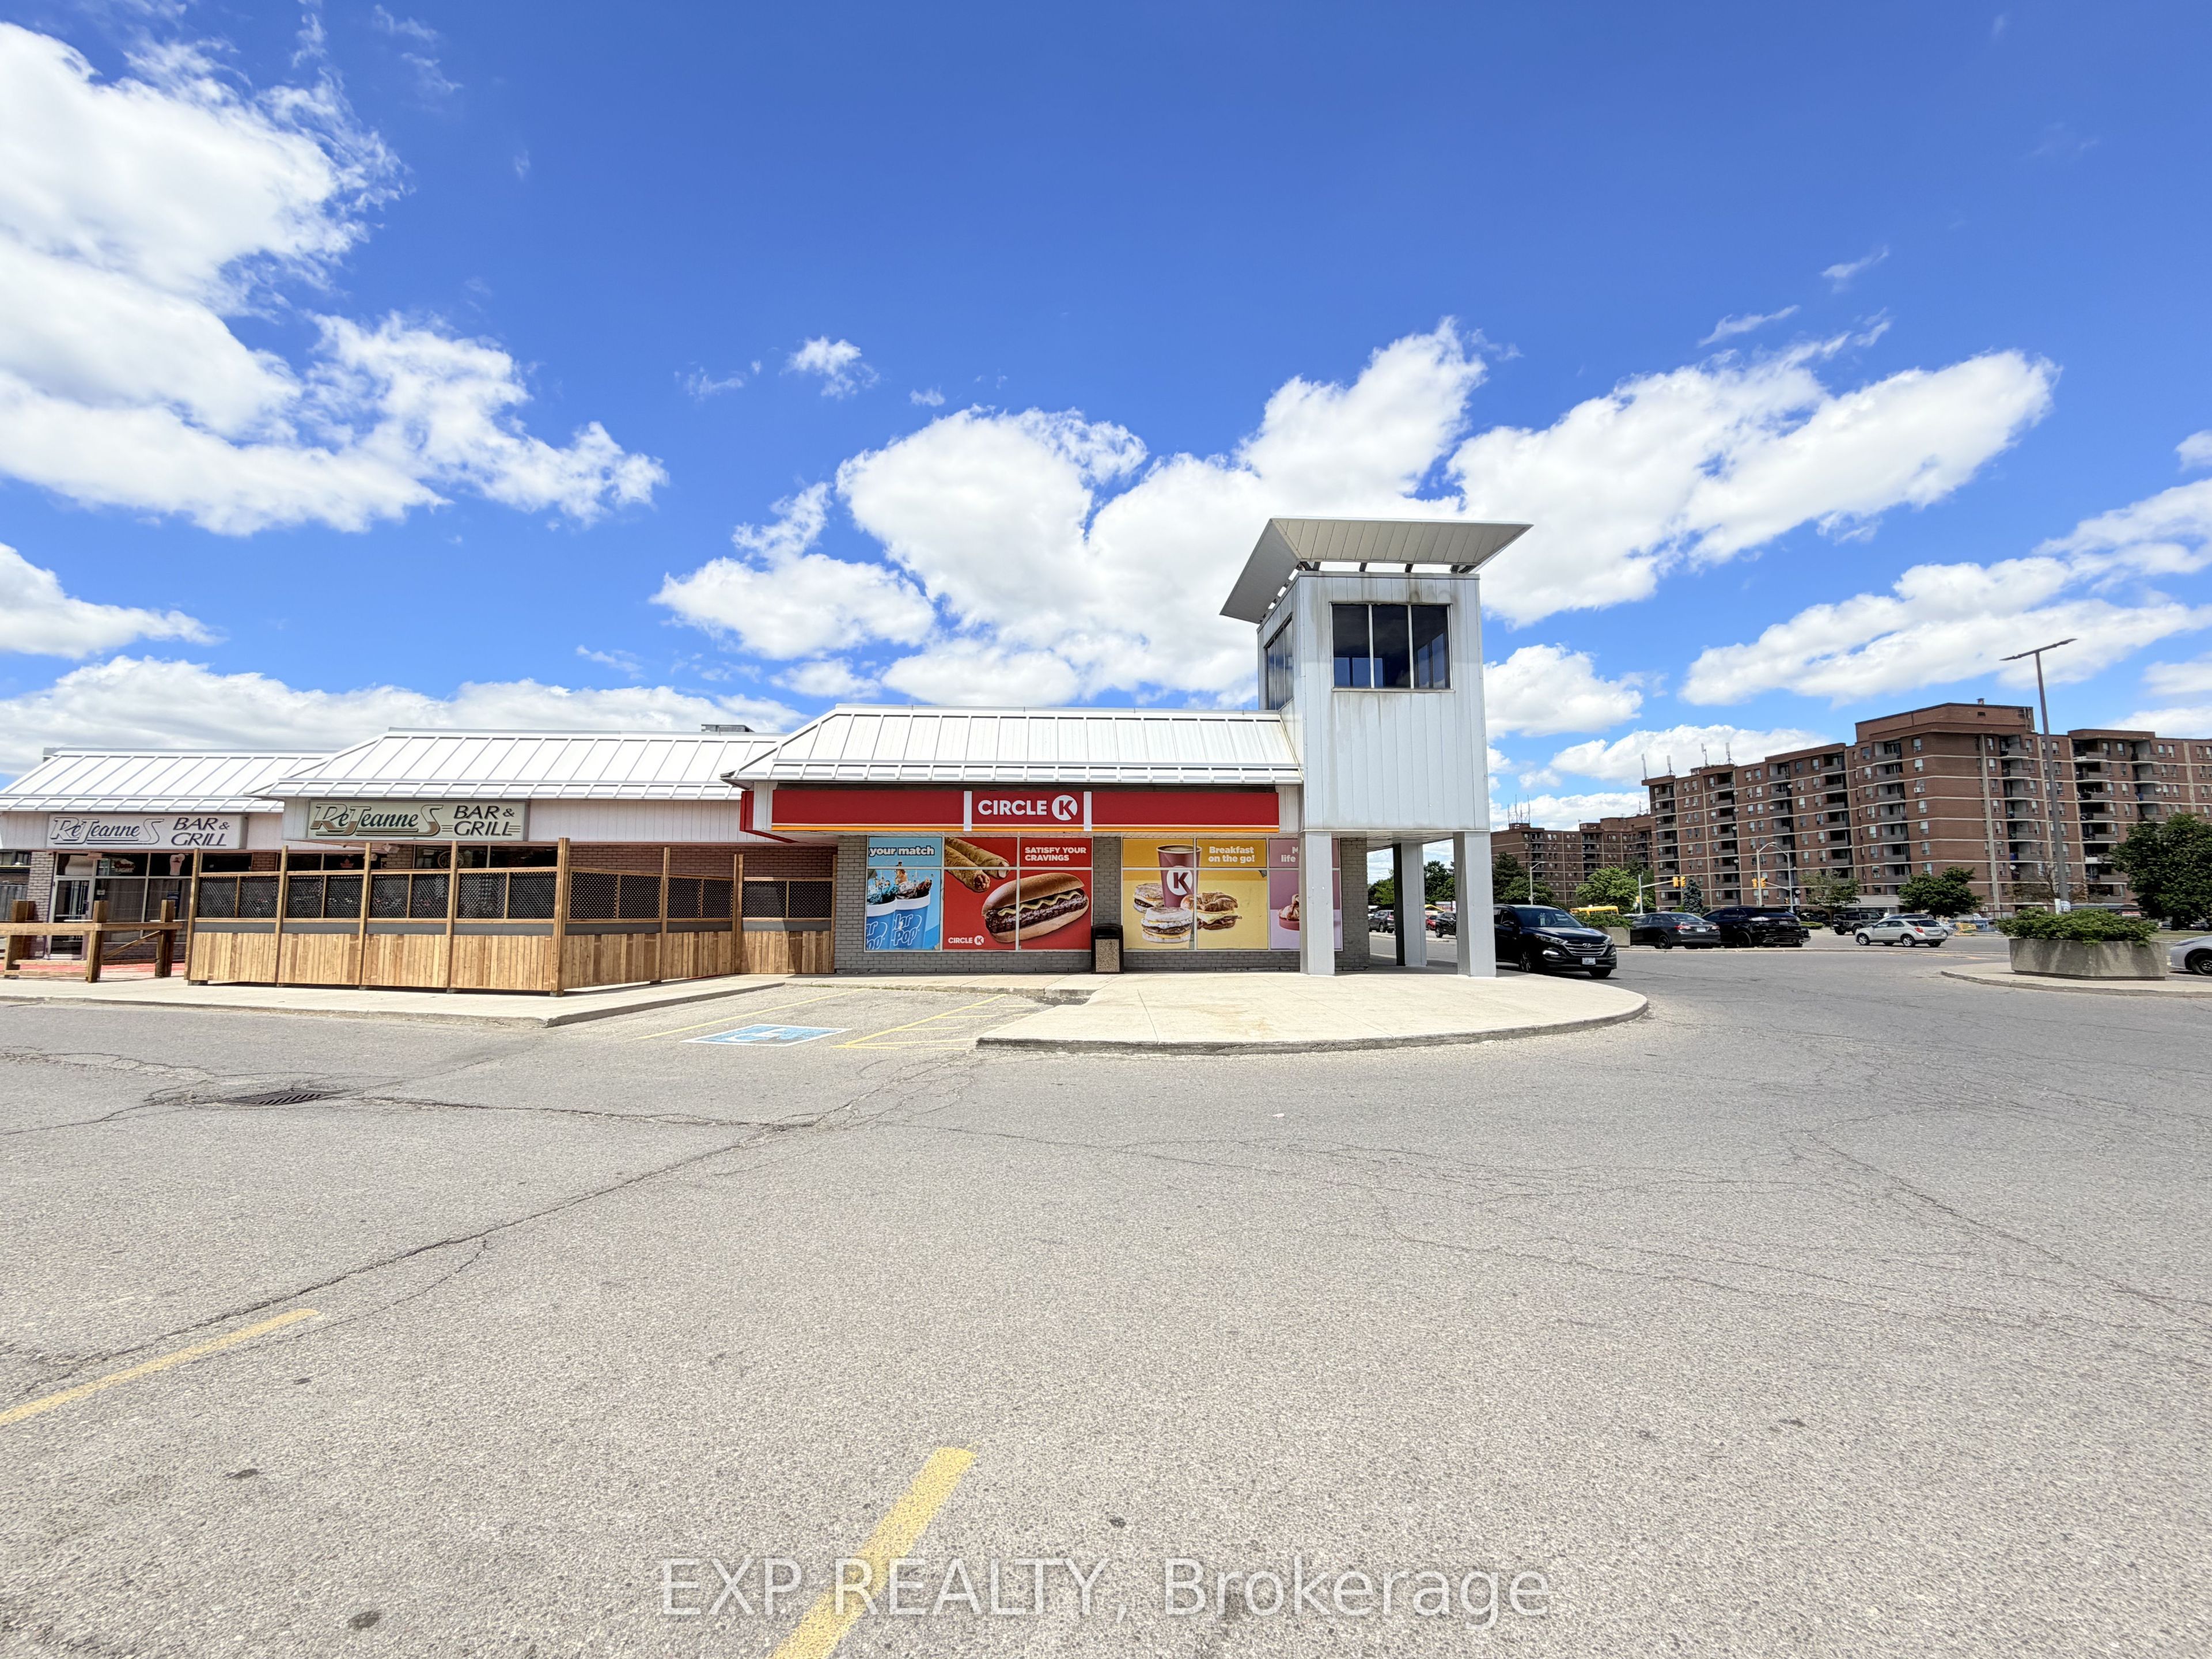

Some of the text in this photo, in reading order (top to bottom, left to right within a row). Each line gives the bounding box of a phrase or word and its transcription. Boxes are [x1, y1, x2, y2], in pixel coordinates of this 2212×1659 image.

[453, 805, 515, 820] BAR &
[978, 798, 1077, 820] CIRCLE K
[172, 817, 230, 831] BAR &
[453, 821, 513, 836] GRILL
[171, 832, 227, 846] GRILL
[869, 845, 935, 857] your match
[1281, 854, 1296, 862] life
[1222, 854, 1238, 862] the
[1240, 854, 1255, 863] go!
[1172, 870, 1192, 895] K
[893, 927, 918, 946] Pop
[975, 936, 983, 945] K
